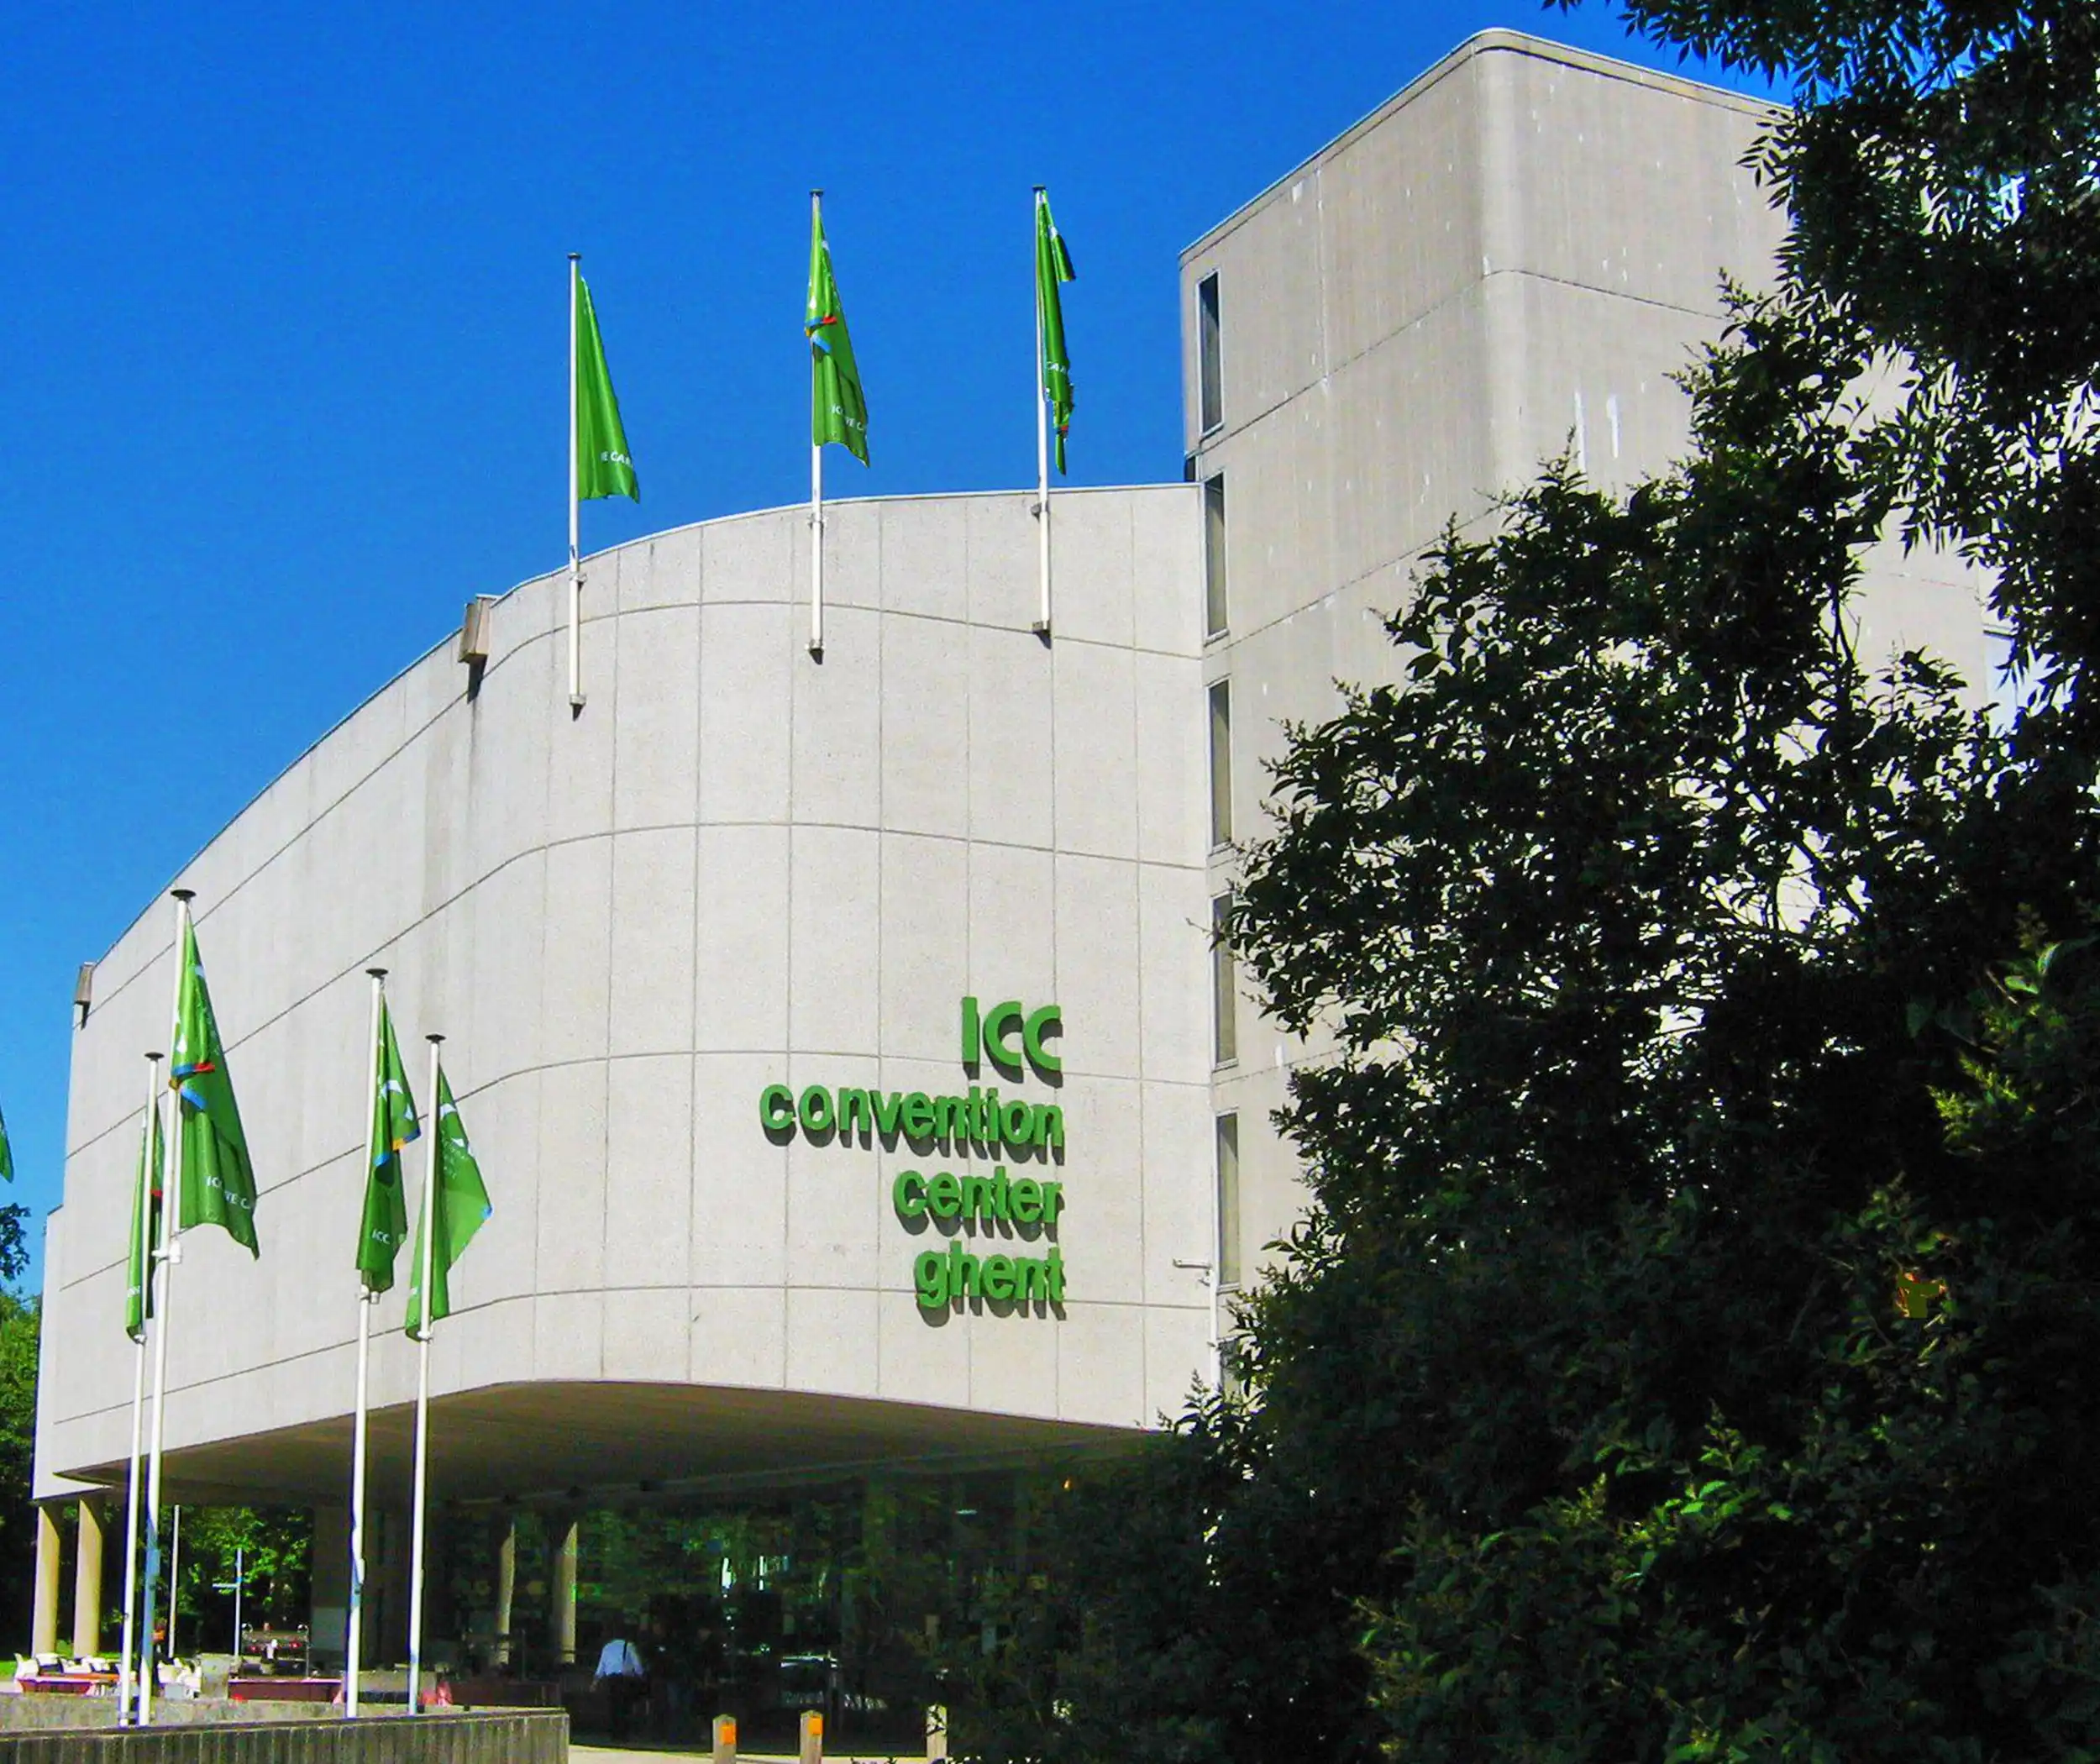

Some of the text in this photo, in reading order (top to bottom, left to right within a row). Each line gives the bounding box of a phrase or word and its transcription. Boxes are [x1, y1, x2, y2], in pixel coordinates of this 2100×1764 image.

[962, 997, 1062, 1075] ICC
[759, 1084, 1064, 1152] convention
[893, 1166, 1064, 1230] center
[915, 1241, 1066, 1316] ghent
